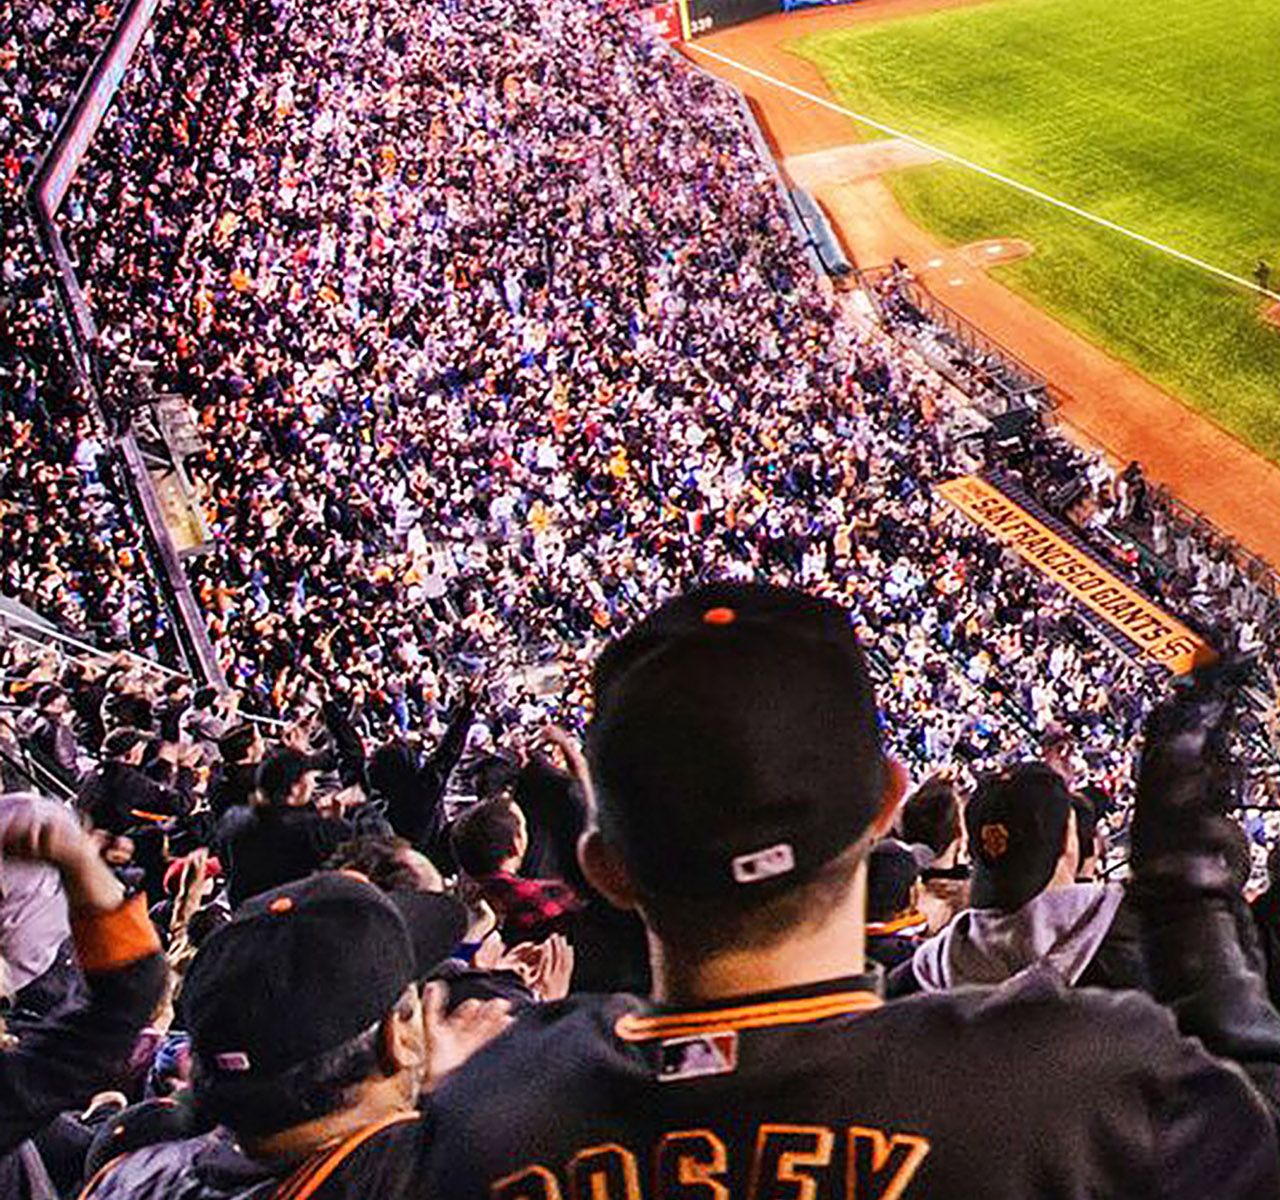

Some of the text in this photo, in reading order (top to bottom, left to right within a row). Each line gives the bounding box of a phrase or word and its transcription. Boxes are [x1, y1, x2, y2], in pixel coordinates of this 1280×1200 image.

[970, 497, 1172, 645] SAN FRANCISCO GIANTS
